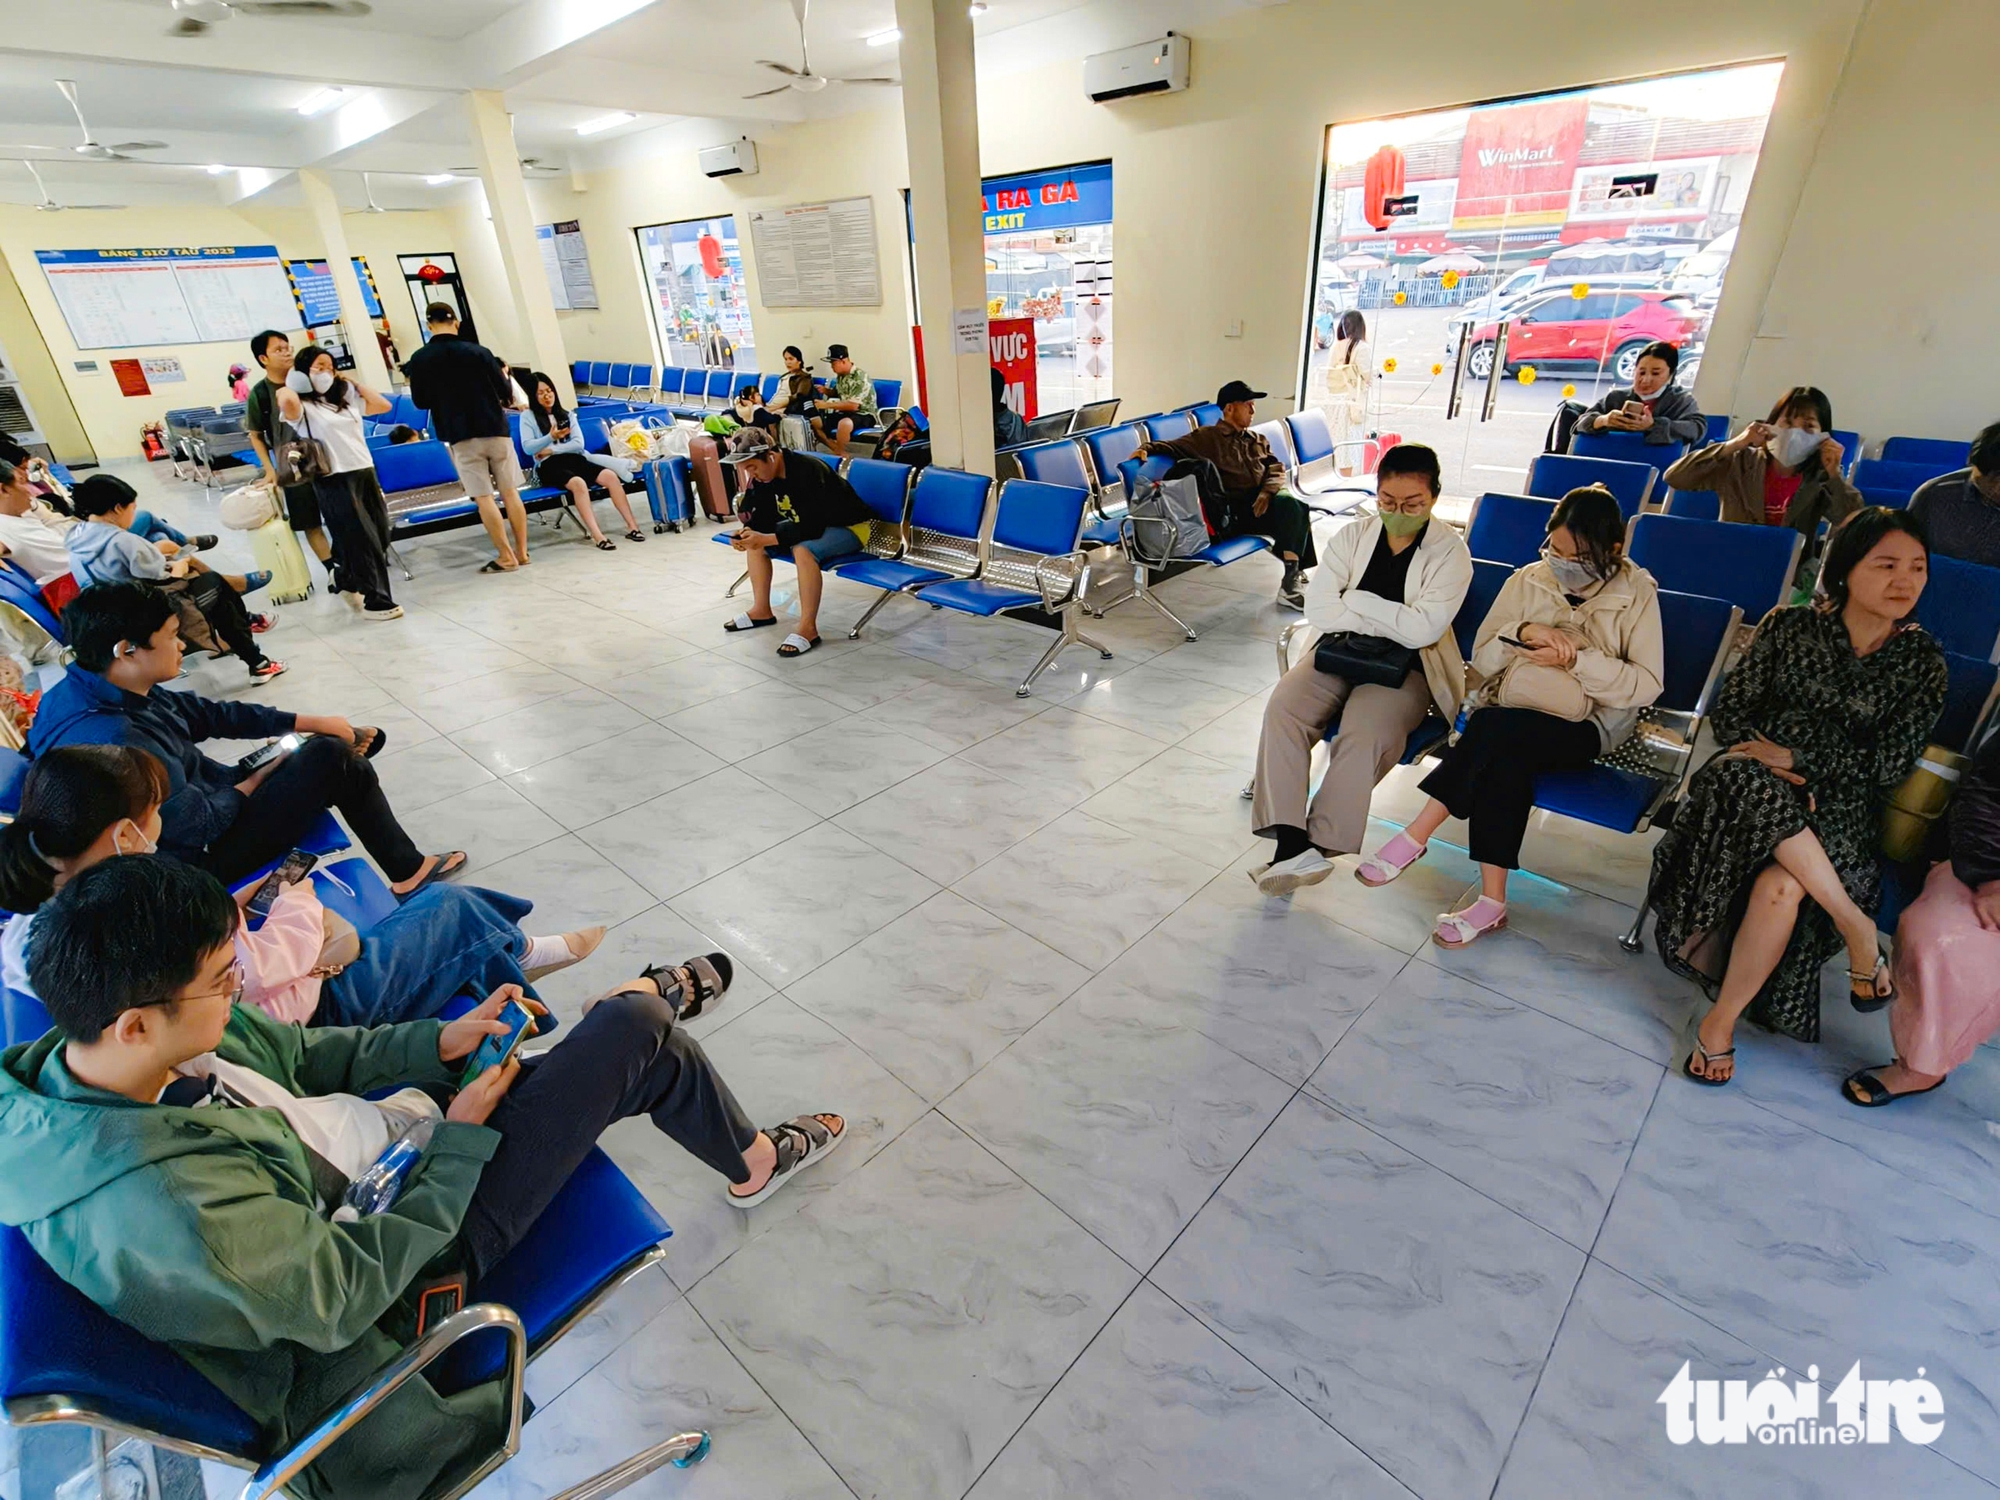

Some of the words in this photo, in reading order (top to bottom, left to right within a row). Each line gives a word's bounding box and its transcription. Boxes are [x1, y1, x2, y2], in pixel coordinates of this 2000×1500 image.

[1477, 144, 1555, 168] WinMart
[996, 187, 1032, 211] RA
[1040, 180, 1080, 206] GA
[985, 213, 1025, 231] EXIT
[990, 331, 1028, 367] VỰC
